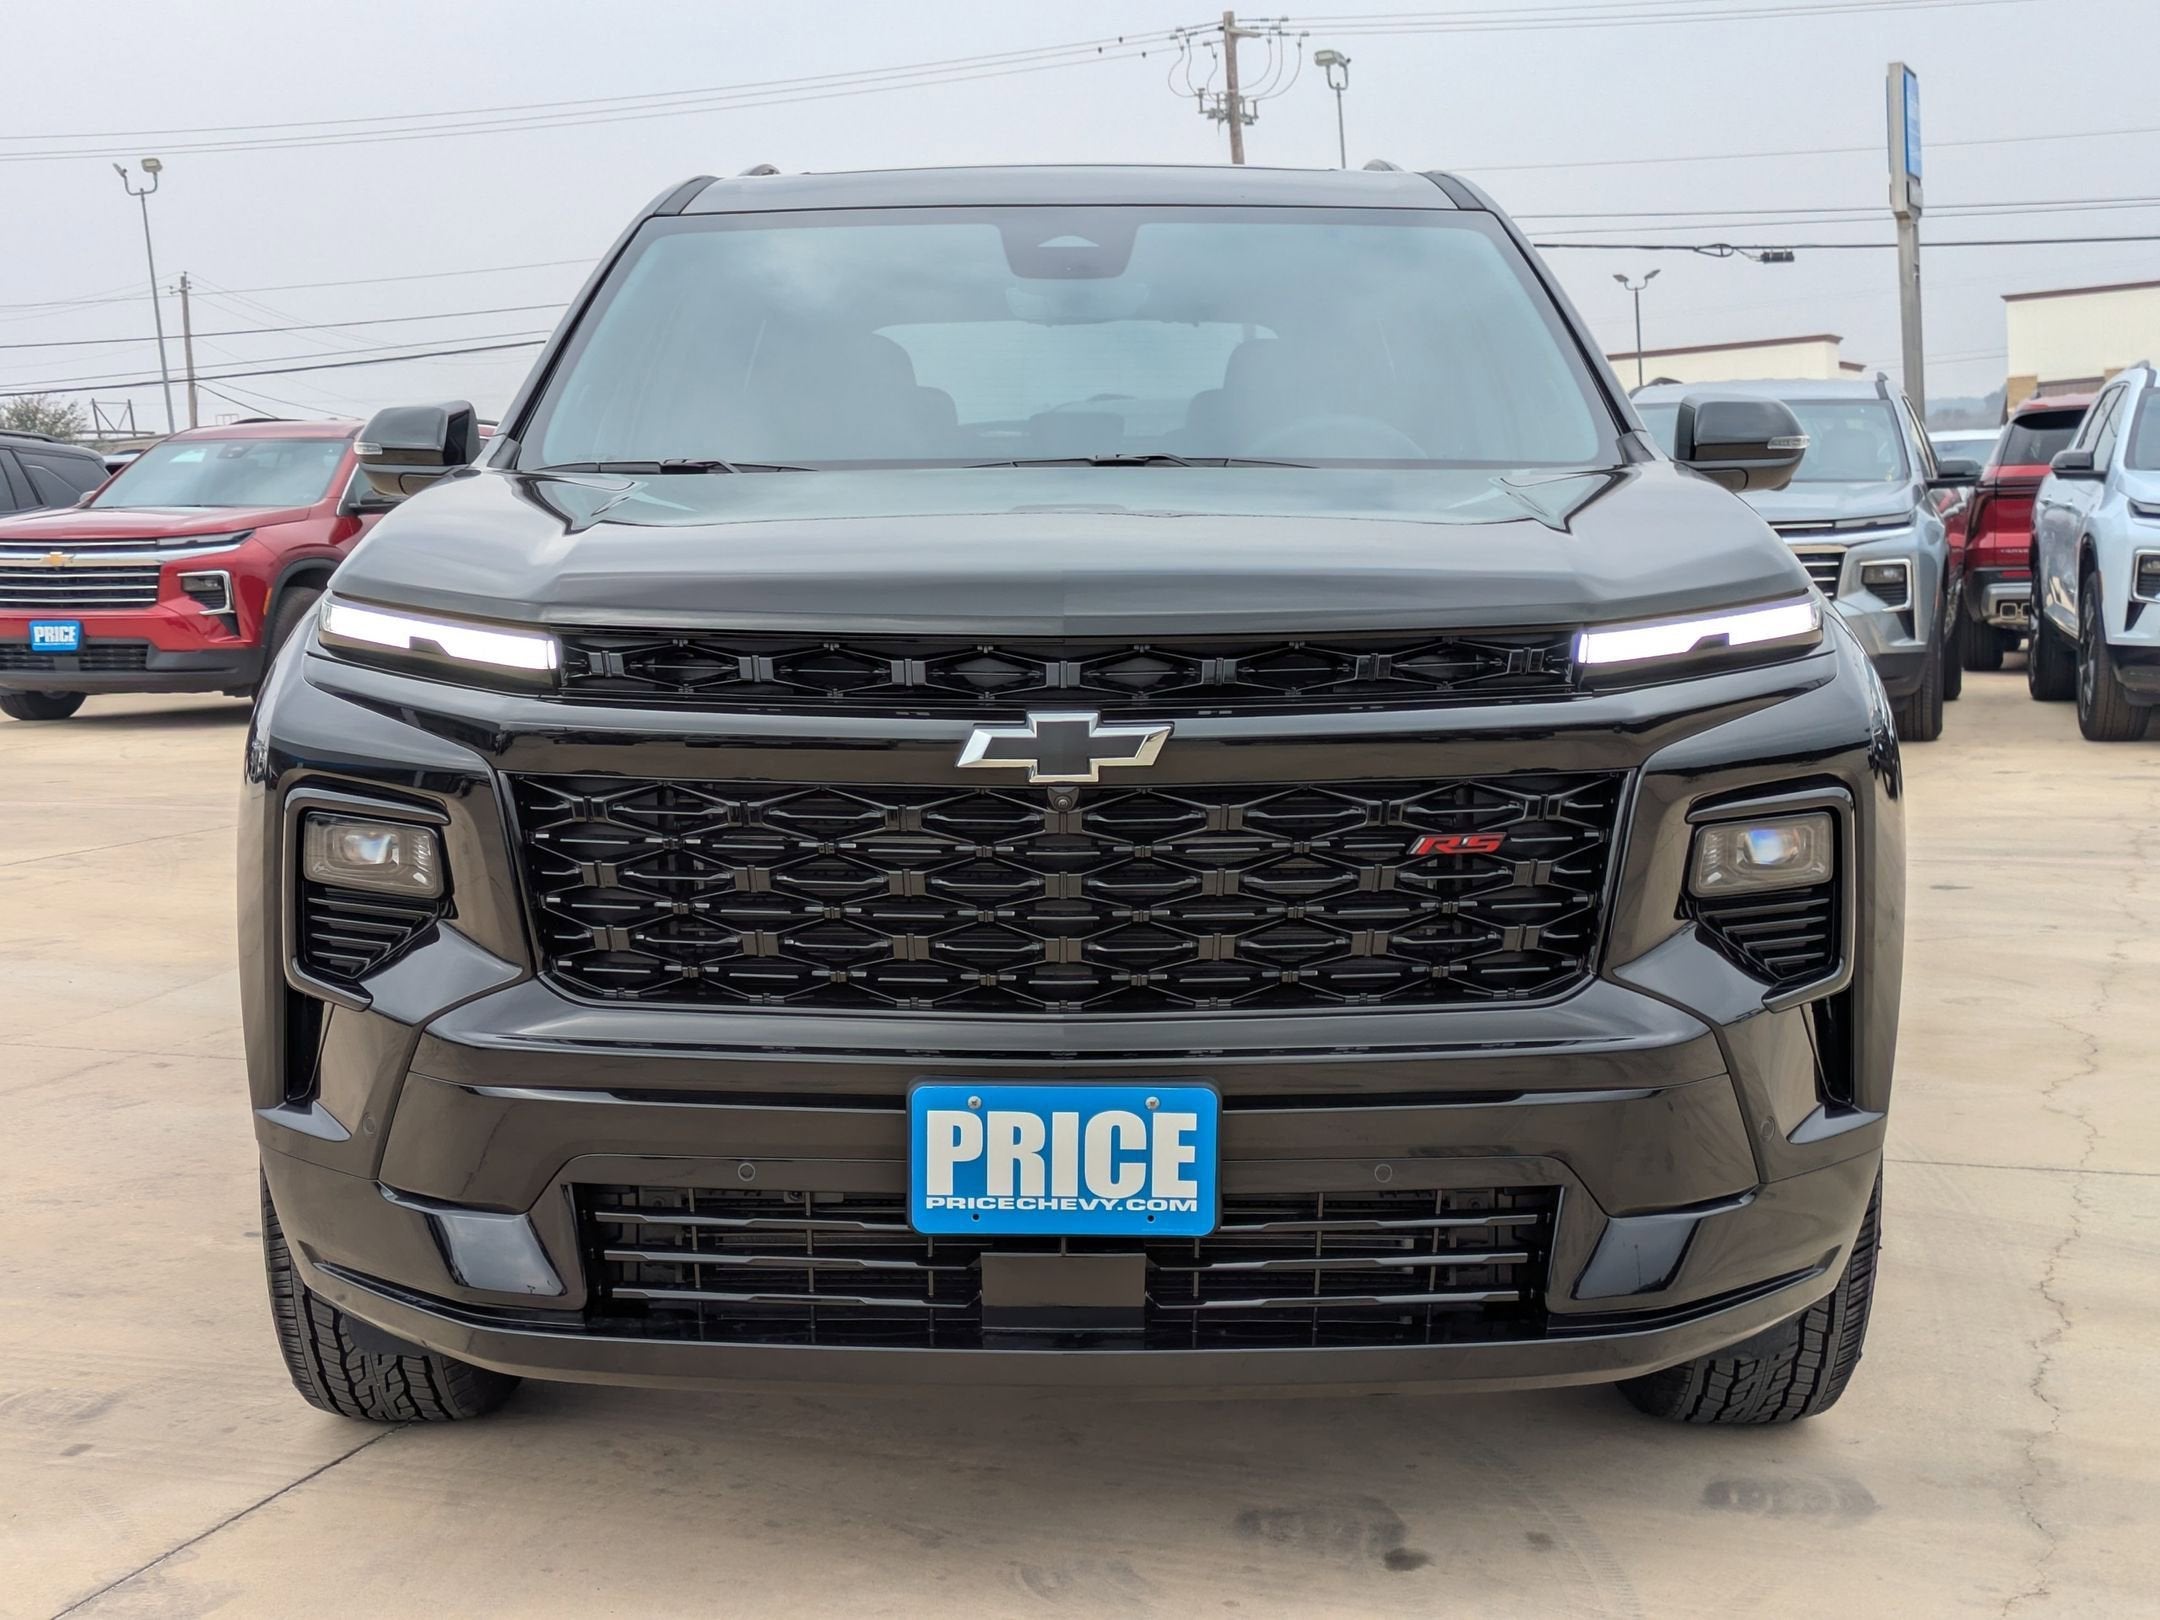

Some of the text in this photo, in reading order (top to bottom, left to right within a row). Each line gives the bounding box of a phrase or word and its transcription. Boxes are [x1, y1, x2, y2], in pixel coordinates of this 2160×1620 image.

[33, 625, 76, 643] PRICE
[1408, 833, 1505, 856] RS
[926, 1110, 1198, 1199] PRICE
[926, 1197, 1198, 1212] PRICECHEVY.COM
